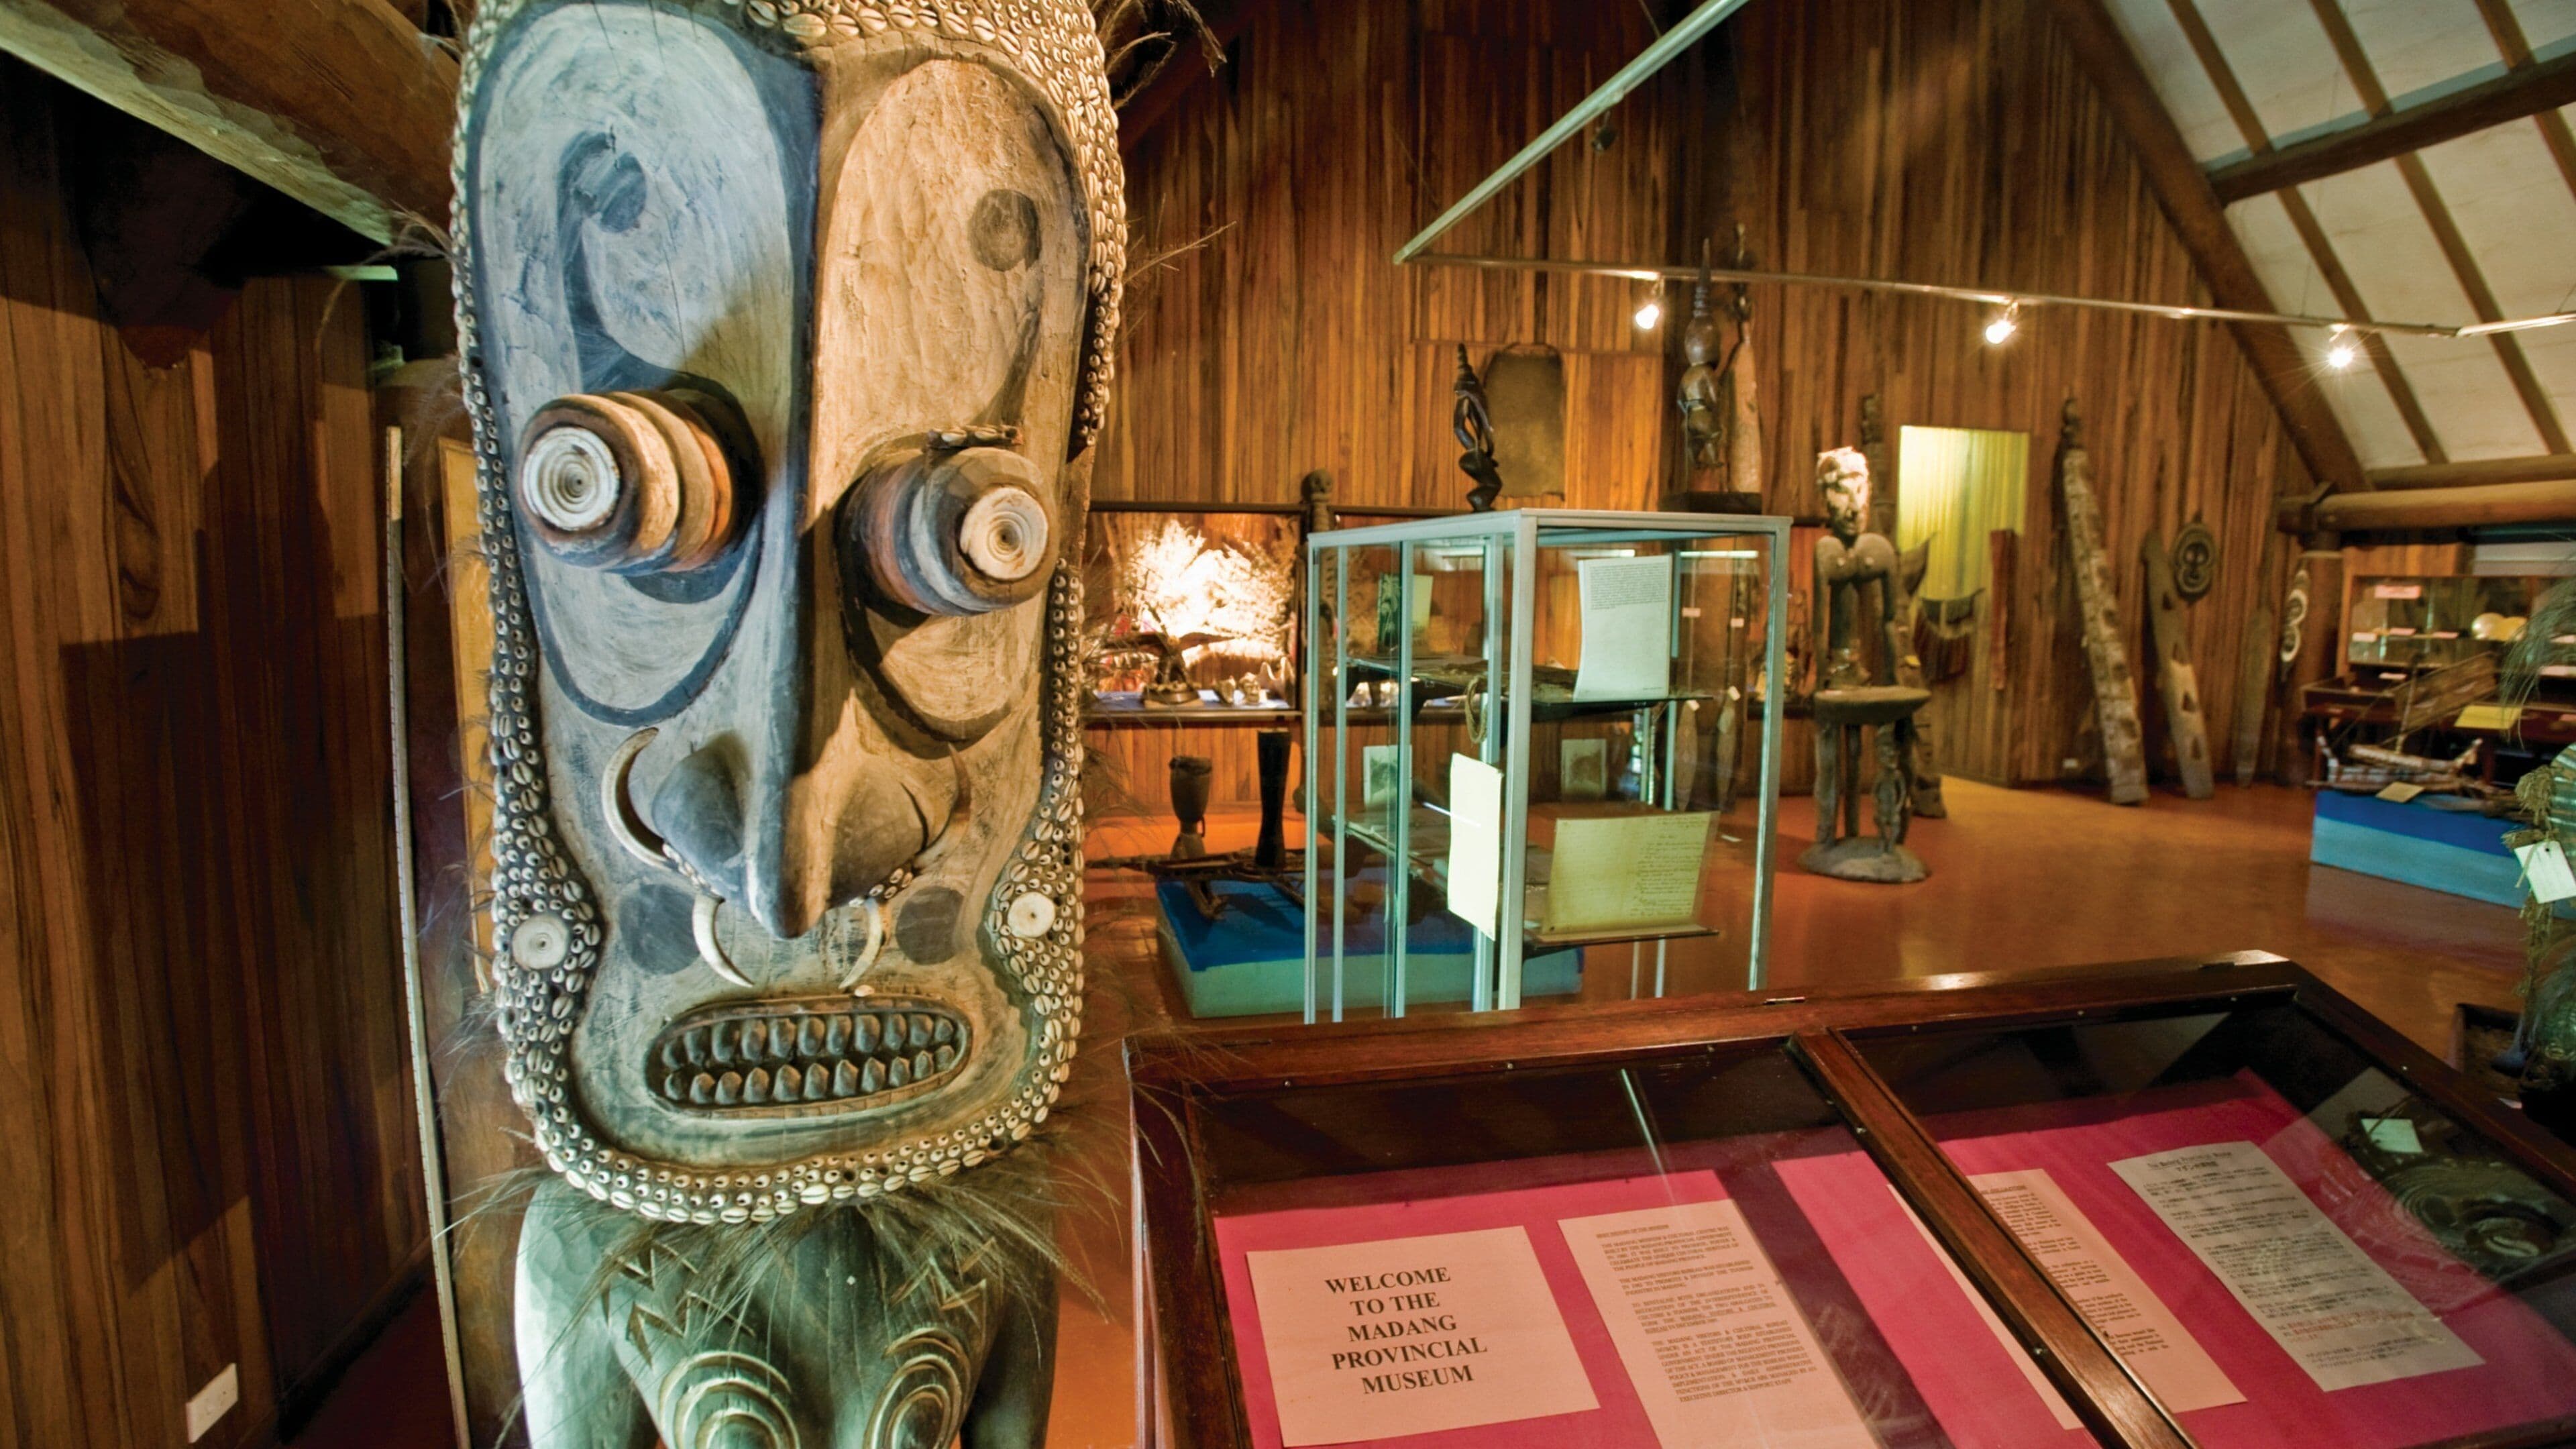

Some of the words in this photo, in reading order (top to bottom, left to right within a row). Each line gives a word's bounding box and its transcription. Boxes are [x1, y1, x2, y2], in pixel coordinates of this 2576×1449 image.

[1324, 1267, 1451, 1295] WELCOME
[1349, 1298, 1385, 1316] TO
[1389, 1292, 1440, 1311] THE
[1347, 1312, 1456, 1343] MADANG
[1332, 1336, 1487, 1371] PROVINCIAL
[1360, 1363, 1474, 1395] MUSEUM
